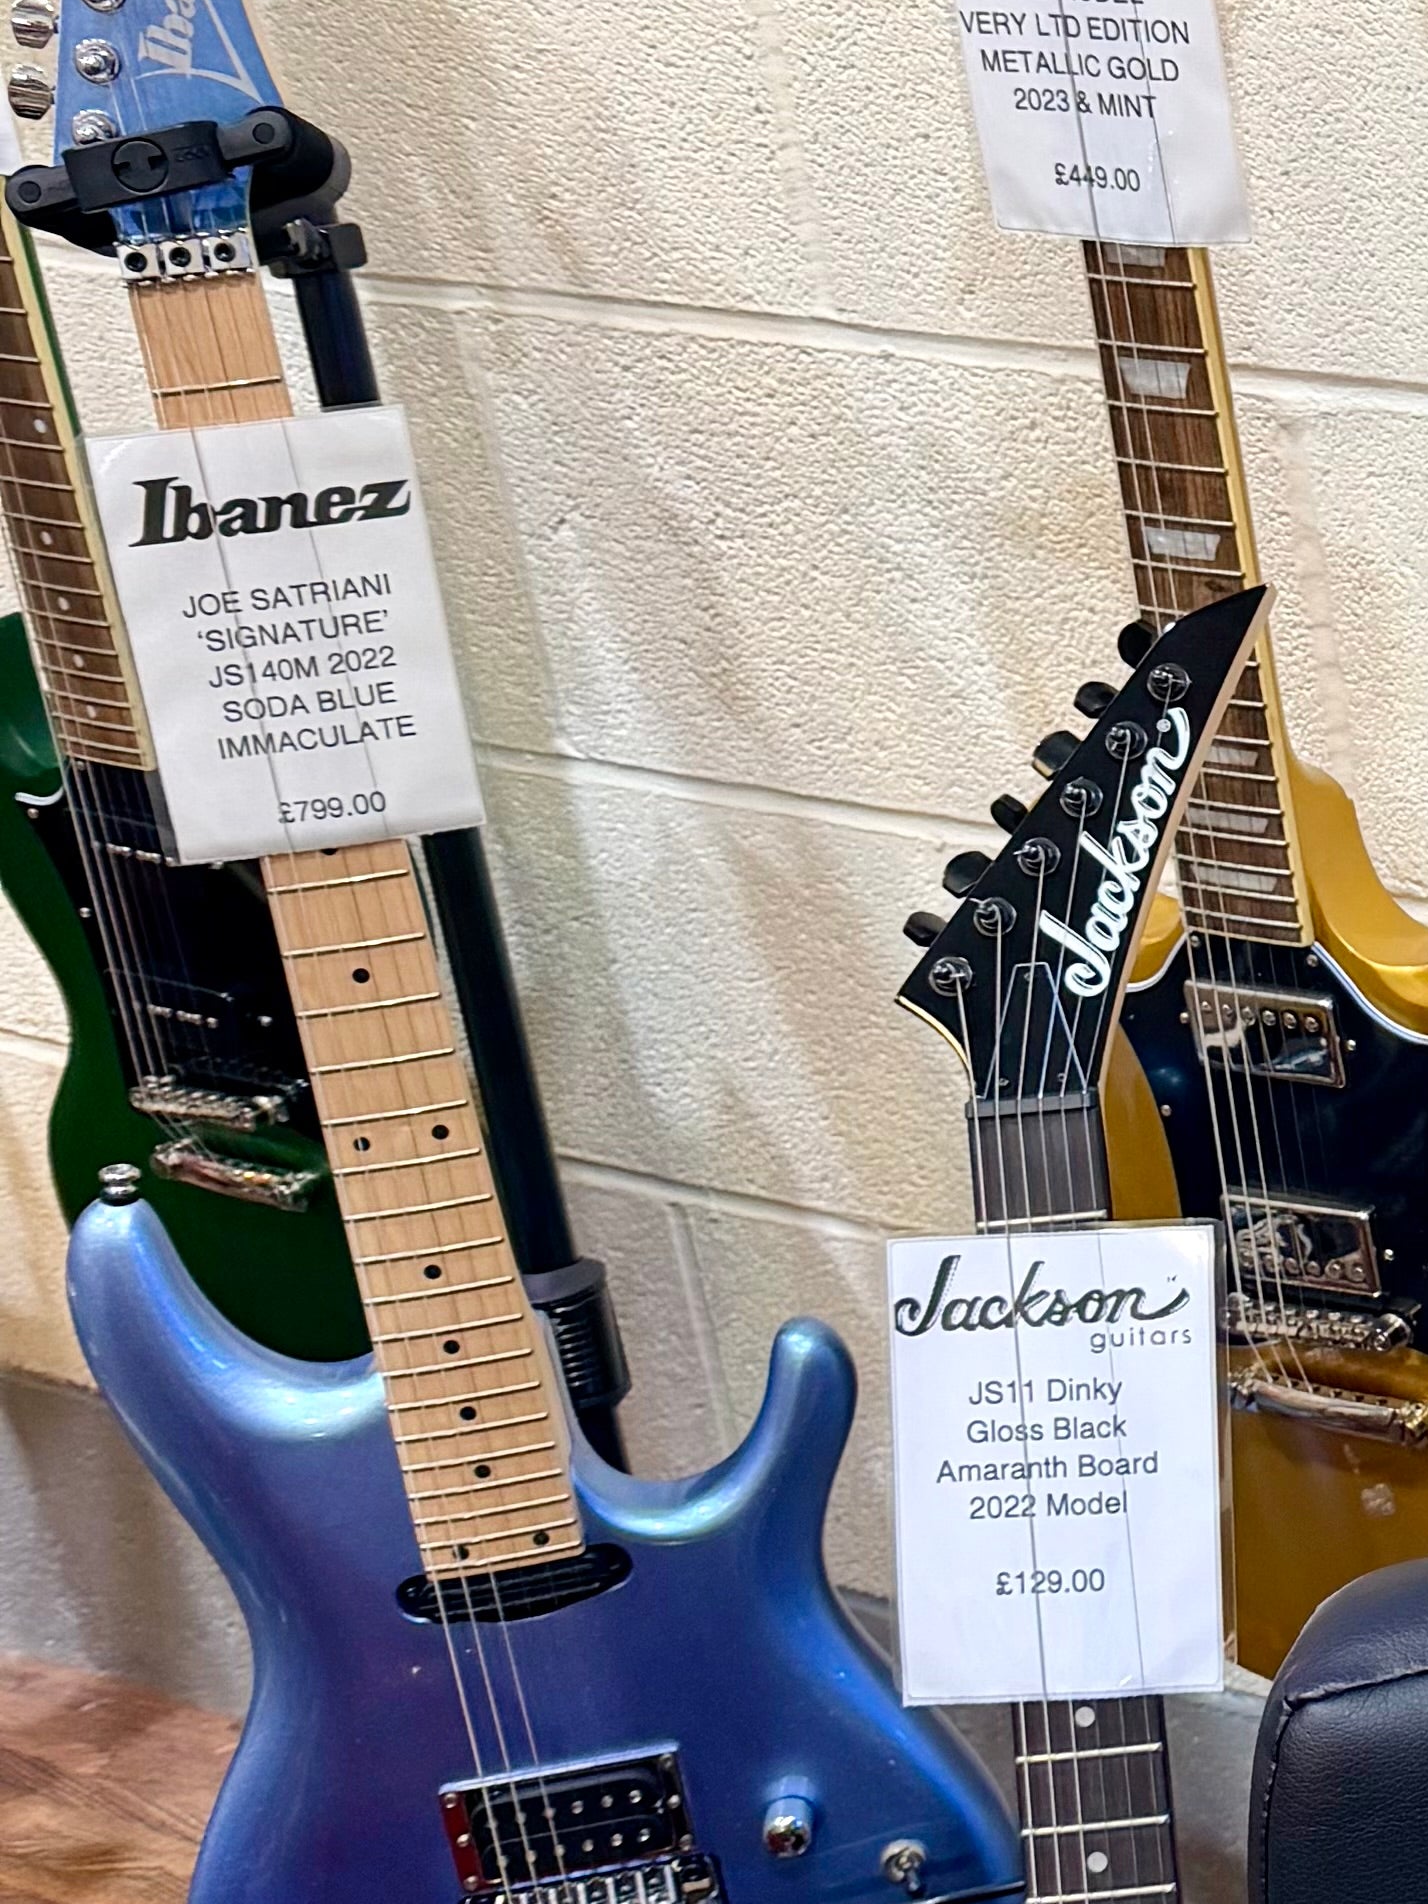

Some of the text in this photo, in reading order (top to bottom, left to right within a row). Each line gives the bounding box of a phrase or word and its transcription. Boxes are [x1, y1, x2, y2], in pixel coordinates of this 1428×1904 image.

[959, 10, 1190, 45] VERY LTD EDITION
[980, 48, 1179, 82] METALLIC GOLD
[1013, 87, 1157, 118] 2023 & MINT
[1054, 162, 1141, 193] £449.00
[128, 476, 411, 548] Ibanez
[182, 573, 392, 619] JOE SATRIANI
[209, 645, 397, 688] JS140M 2022
[223, 681, 398, 723] SODA BLUE
[218, 714, 417, 760] IMMACULATE
[277, 790, 386, 824] £799.00
[1039, 707, 1192, 998] Jackson
[894, 1253, 1191, 1337] Jackson
[1089, 1326, 1193, 1354] guitars
[968, 1378, 1123, 1406] JS11 Dinky
[966, 1414, 1128, 1444] Gloss Black
[936, 1450, 1159, 1484] Amaranth Board
[969, 1491, 1128, 1520] 2022 Model
[995, 1568, 1106, 1597] £129.00
